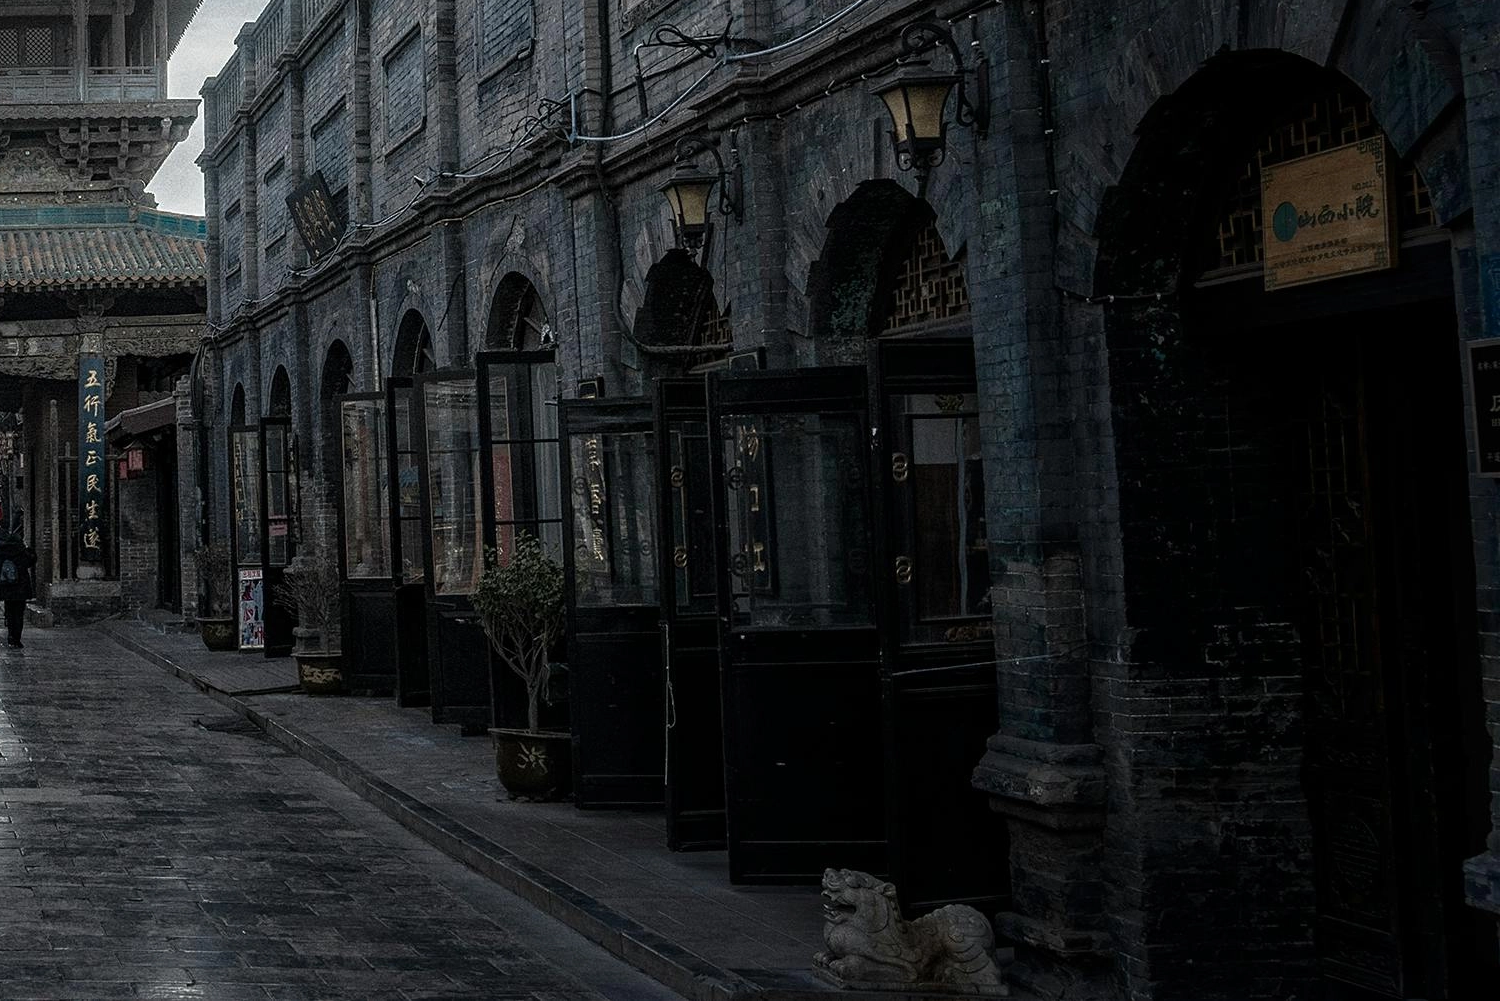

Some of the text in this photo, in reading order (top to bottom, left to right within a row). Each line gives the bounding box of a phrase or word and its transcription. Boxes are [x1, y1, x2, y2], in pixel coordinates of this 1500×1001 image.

[1298, 193, 1380, 228] 山西小院
[83, 369, 102, 550] 五行氣正民生遂
